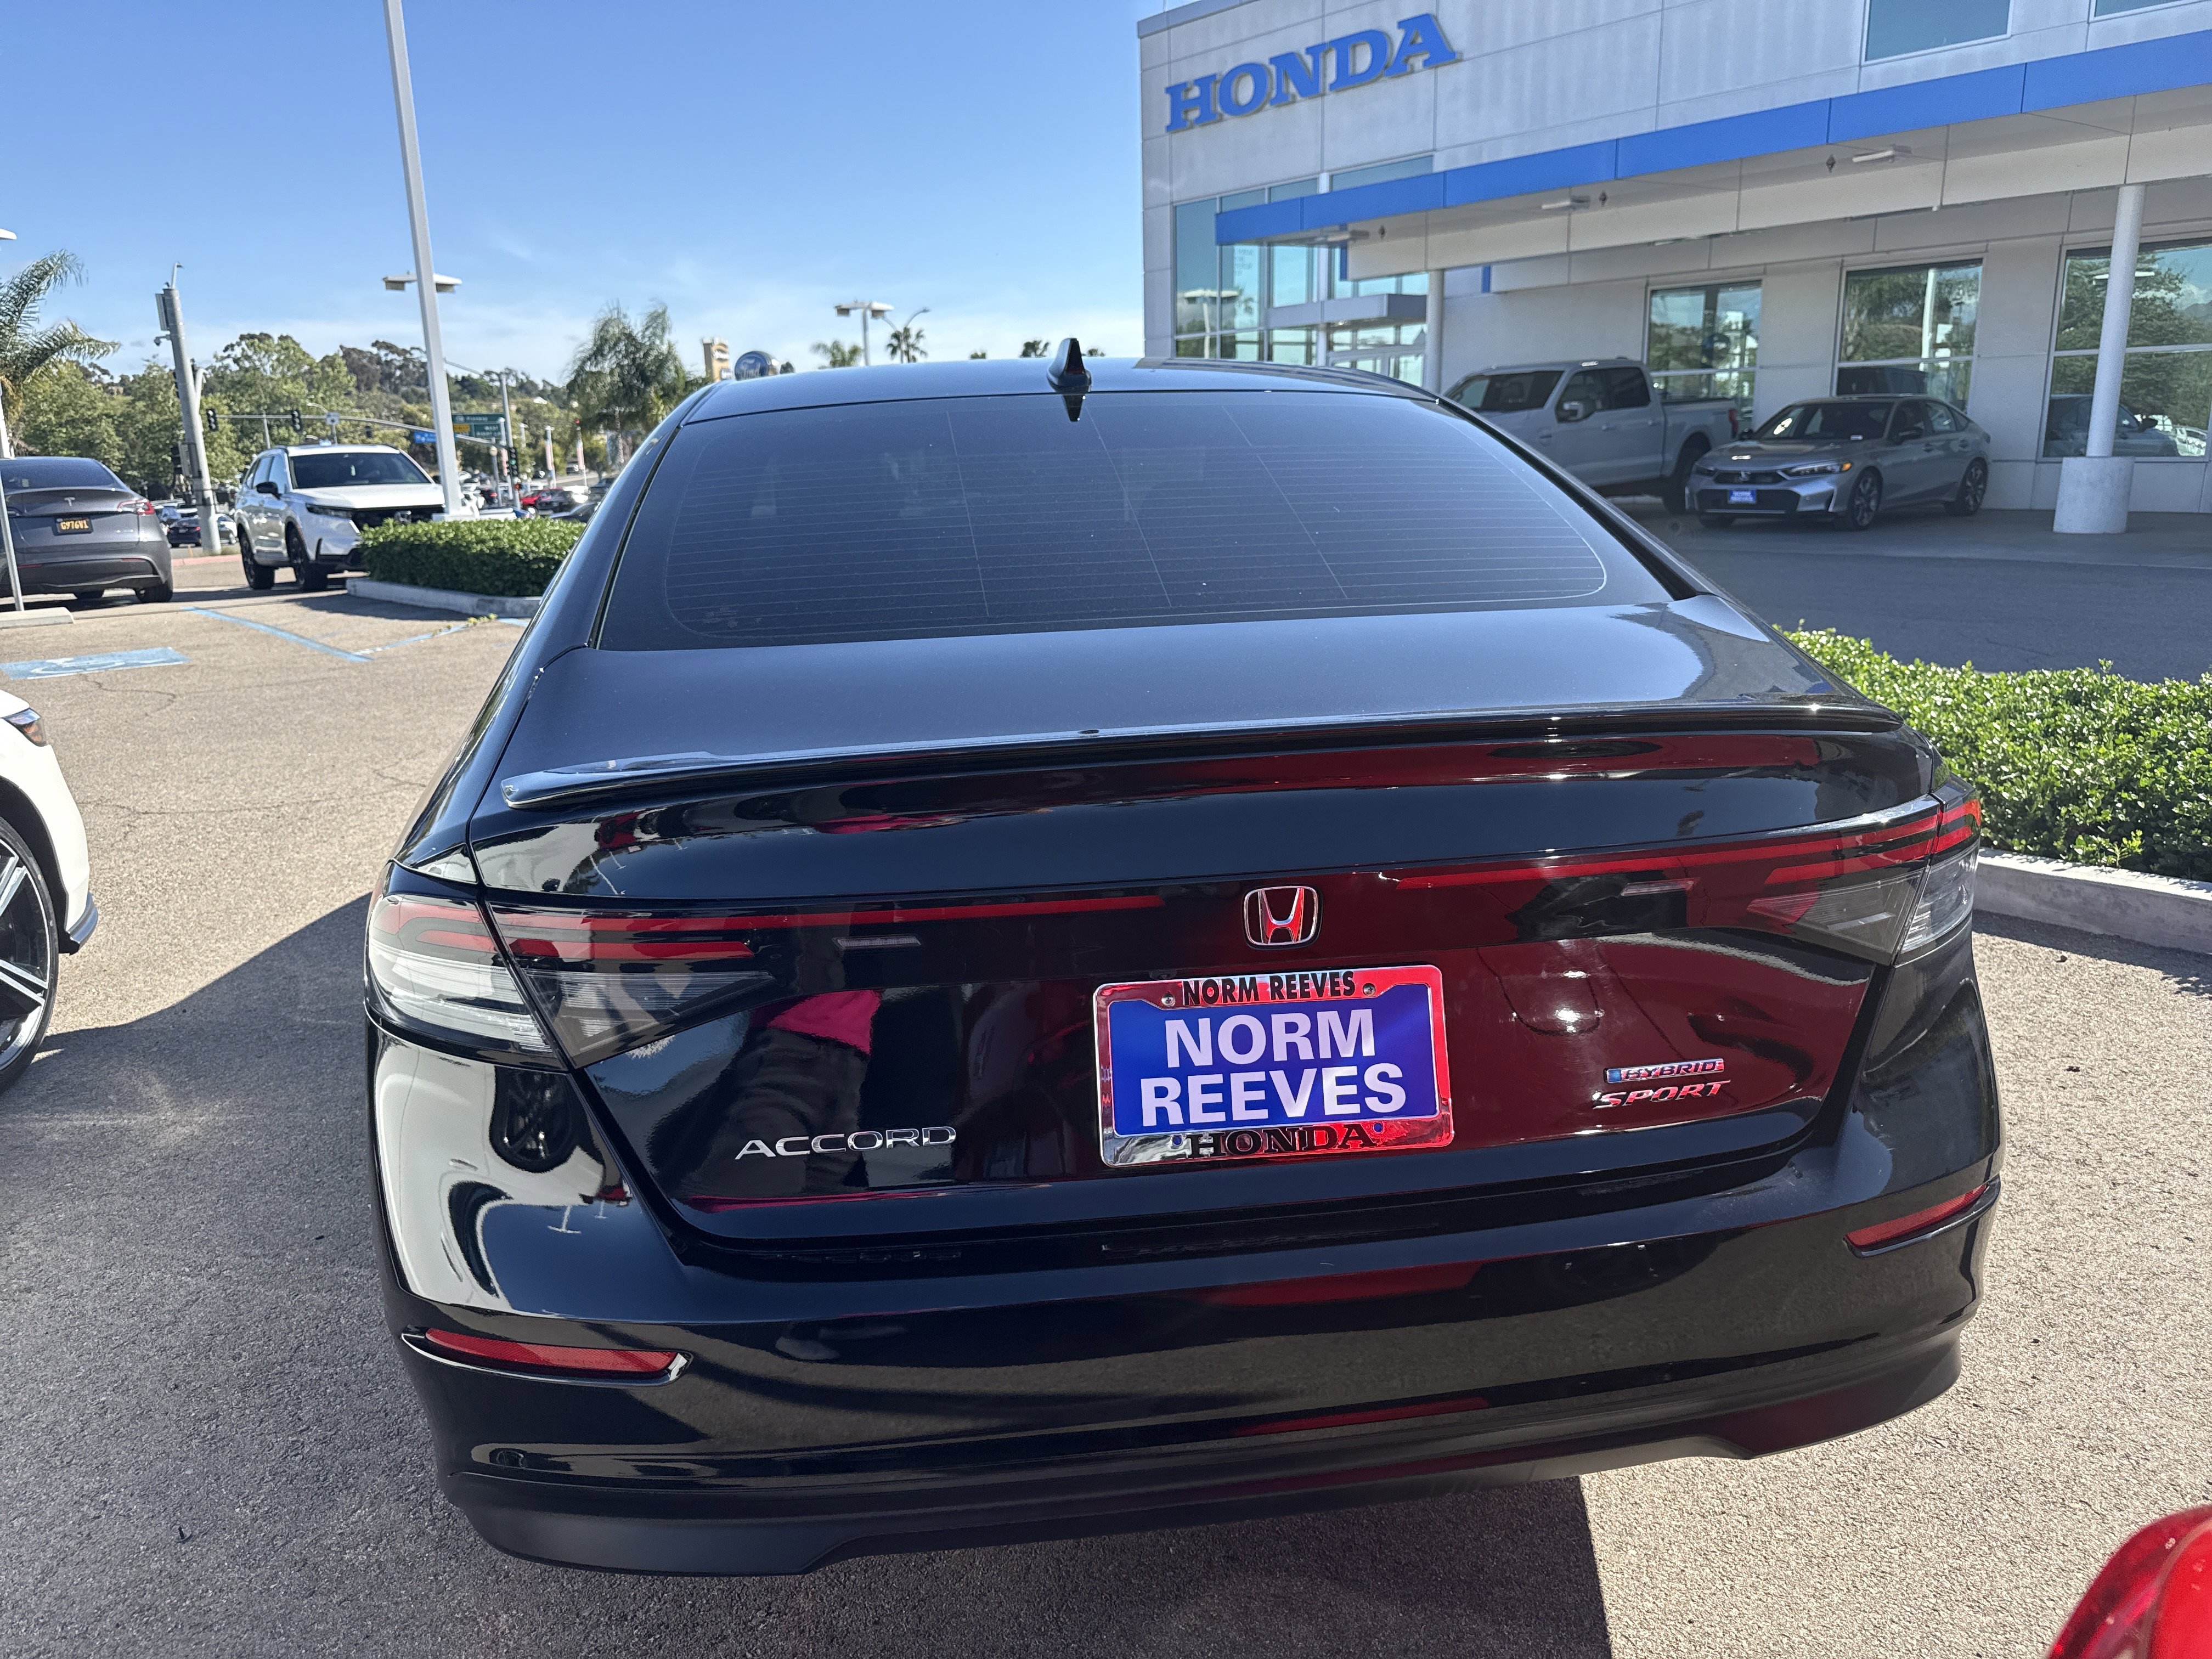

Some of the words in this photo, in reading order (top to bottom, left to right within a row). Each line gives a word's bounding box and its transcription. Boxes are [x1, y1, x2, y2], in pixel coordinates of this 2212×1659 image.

[1164, 13, 1459, 133] HONDA
[1182, 977, 1260, 1007] NORM
[1269, 970, 1356, 1000] REEVES
[1165, 1008, 1376, 1069] NORM
[1624, 1061, 1718, 1079] HYBRID
[1141, 1062, 1407, 1127] REEVES
[1592, 1079, 1731, 1109] SPORT
[734, 1126, 957, 1160] ACCORD
[1188, 1123, 1376, 1157] HONDA
